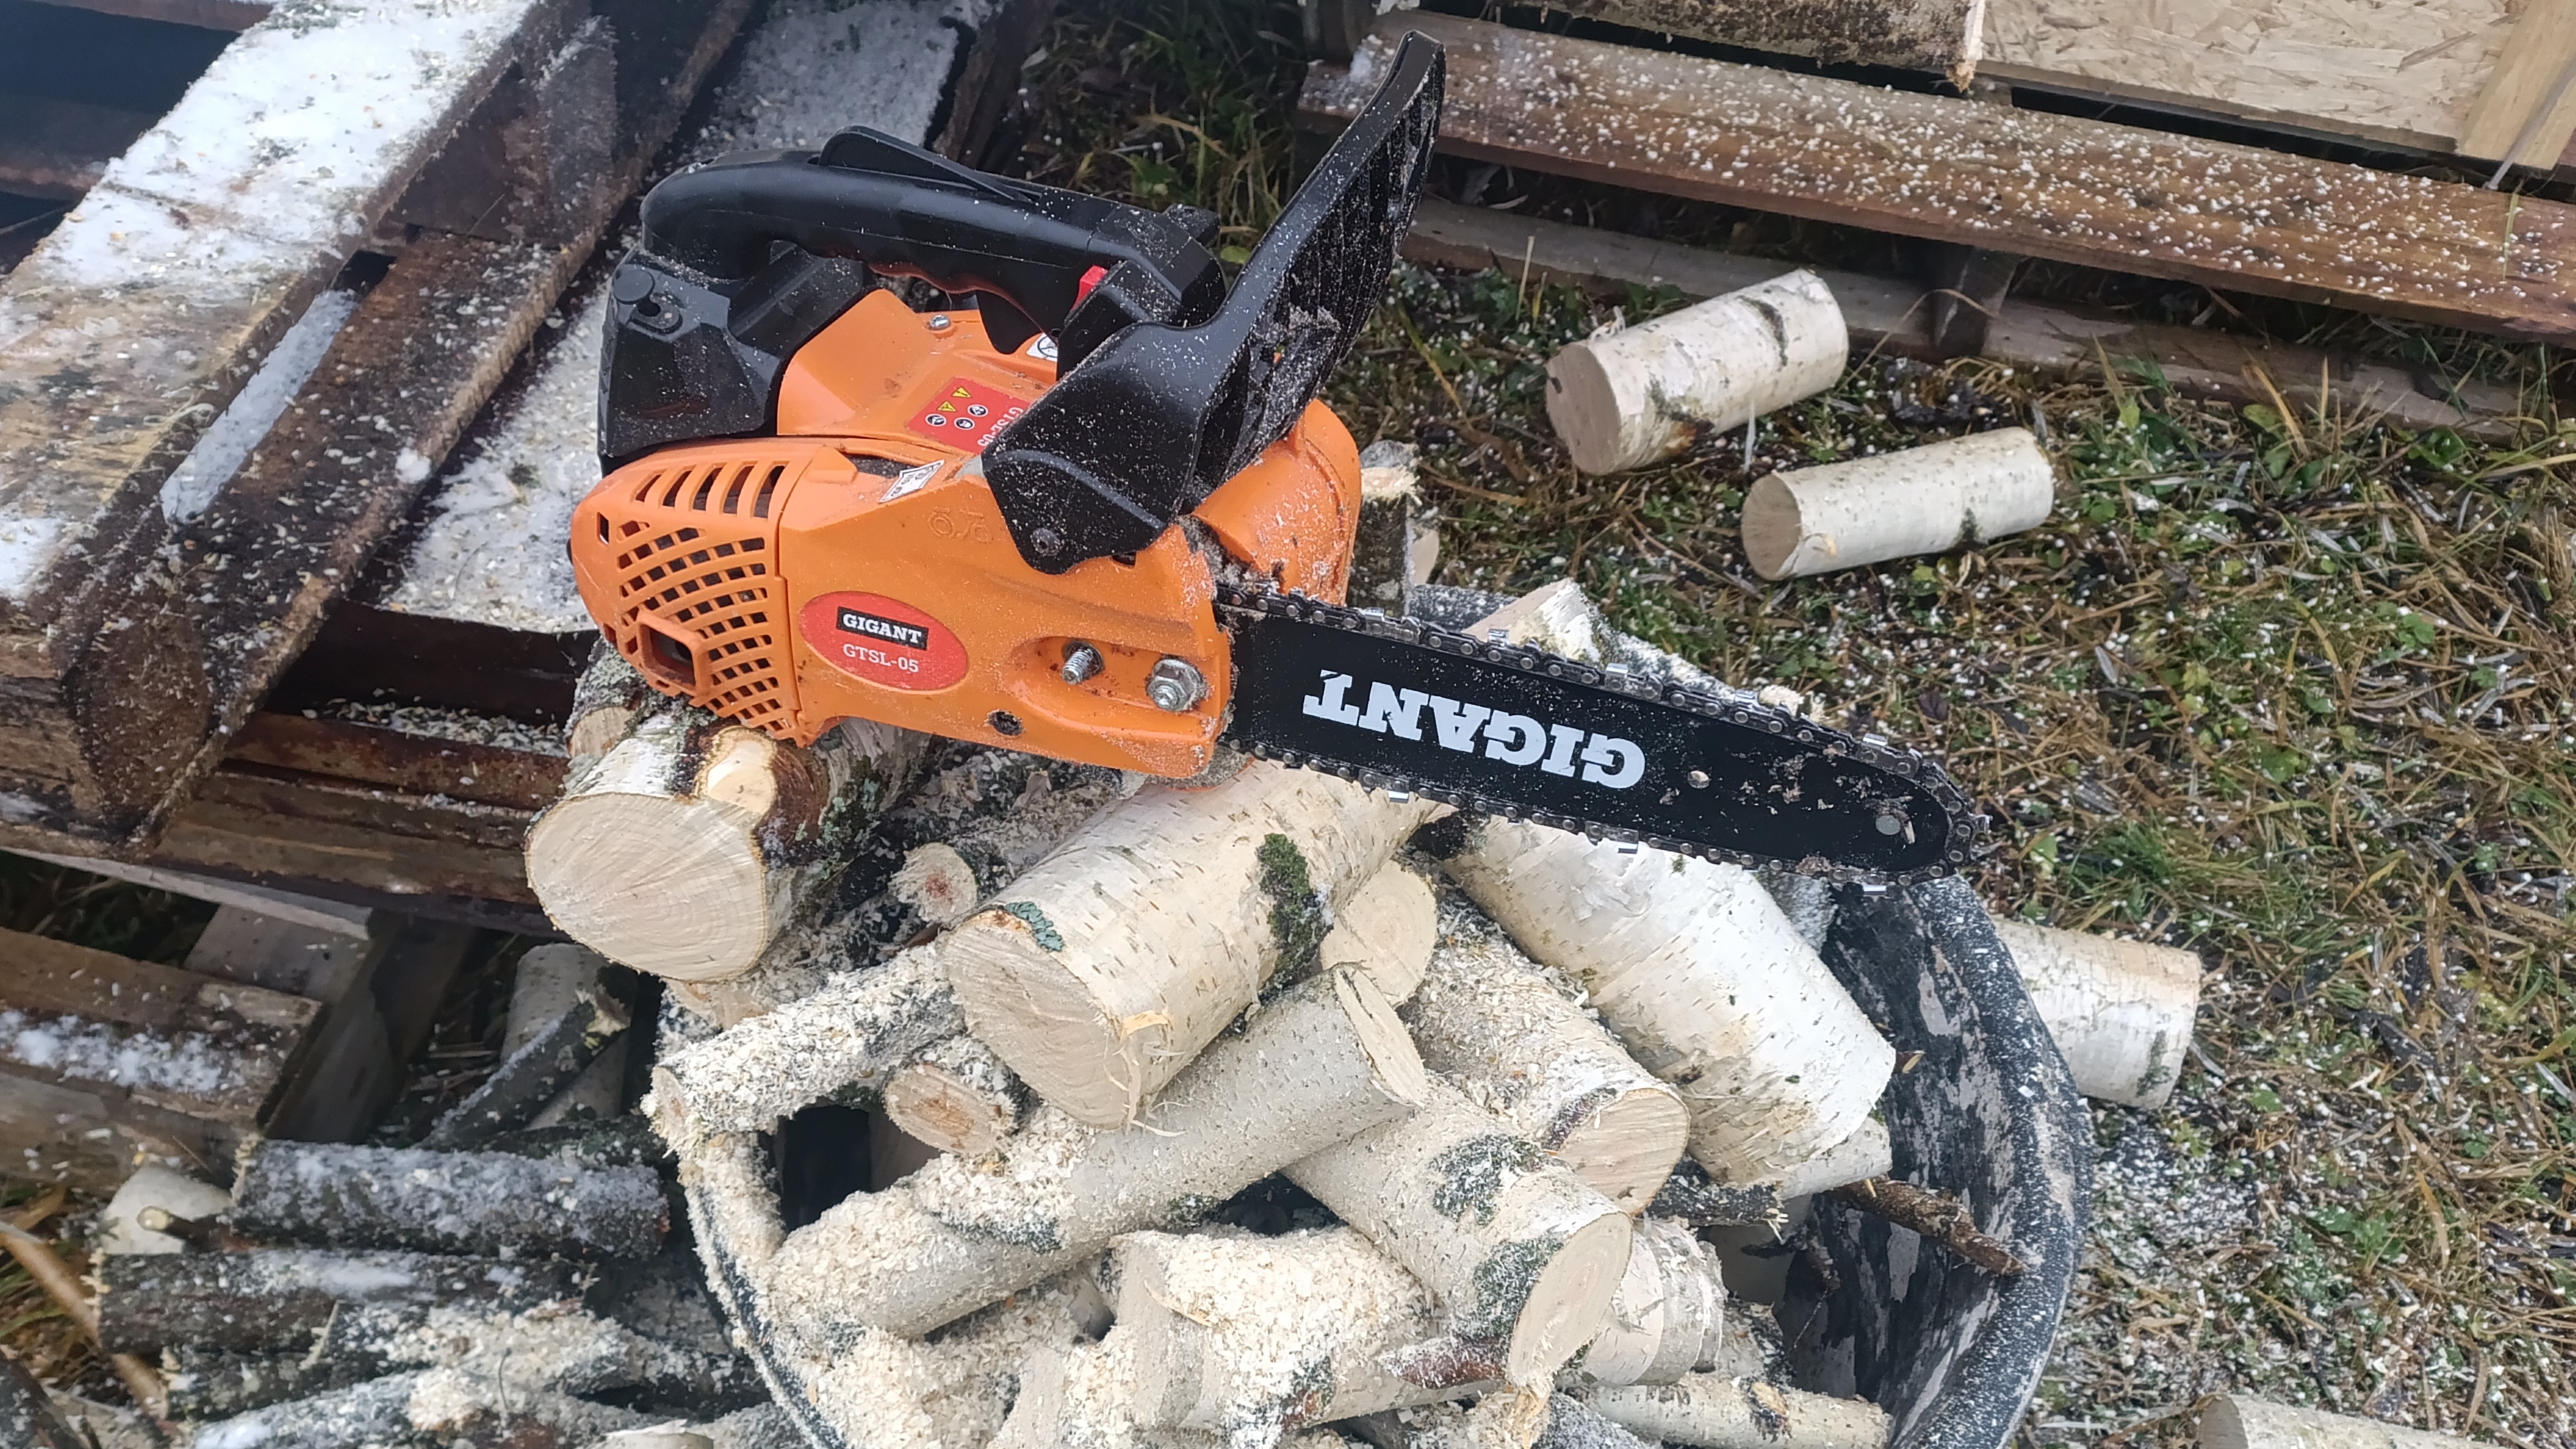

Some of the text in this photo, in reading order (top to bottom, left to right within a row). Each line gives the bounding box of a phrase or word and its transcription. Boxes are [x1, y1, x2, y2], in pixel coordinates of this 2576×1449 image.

[842, 613, 922, 644] GIGANT
[842, 643, 919, 673] GTSL-05
[1302, 669, 1646, 789] GIGANT
